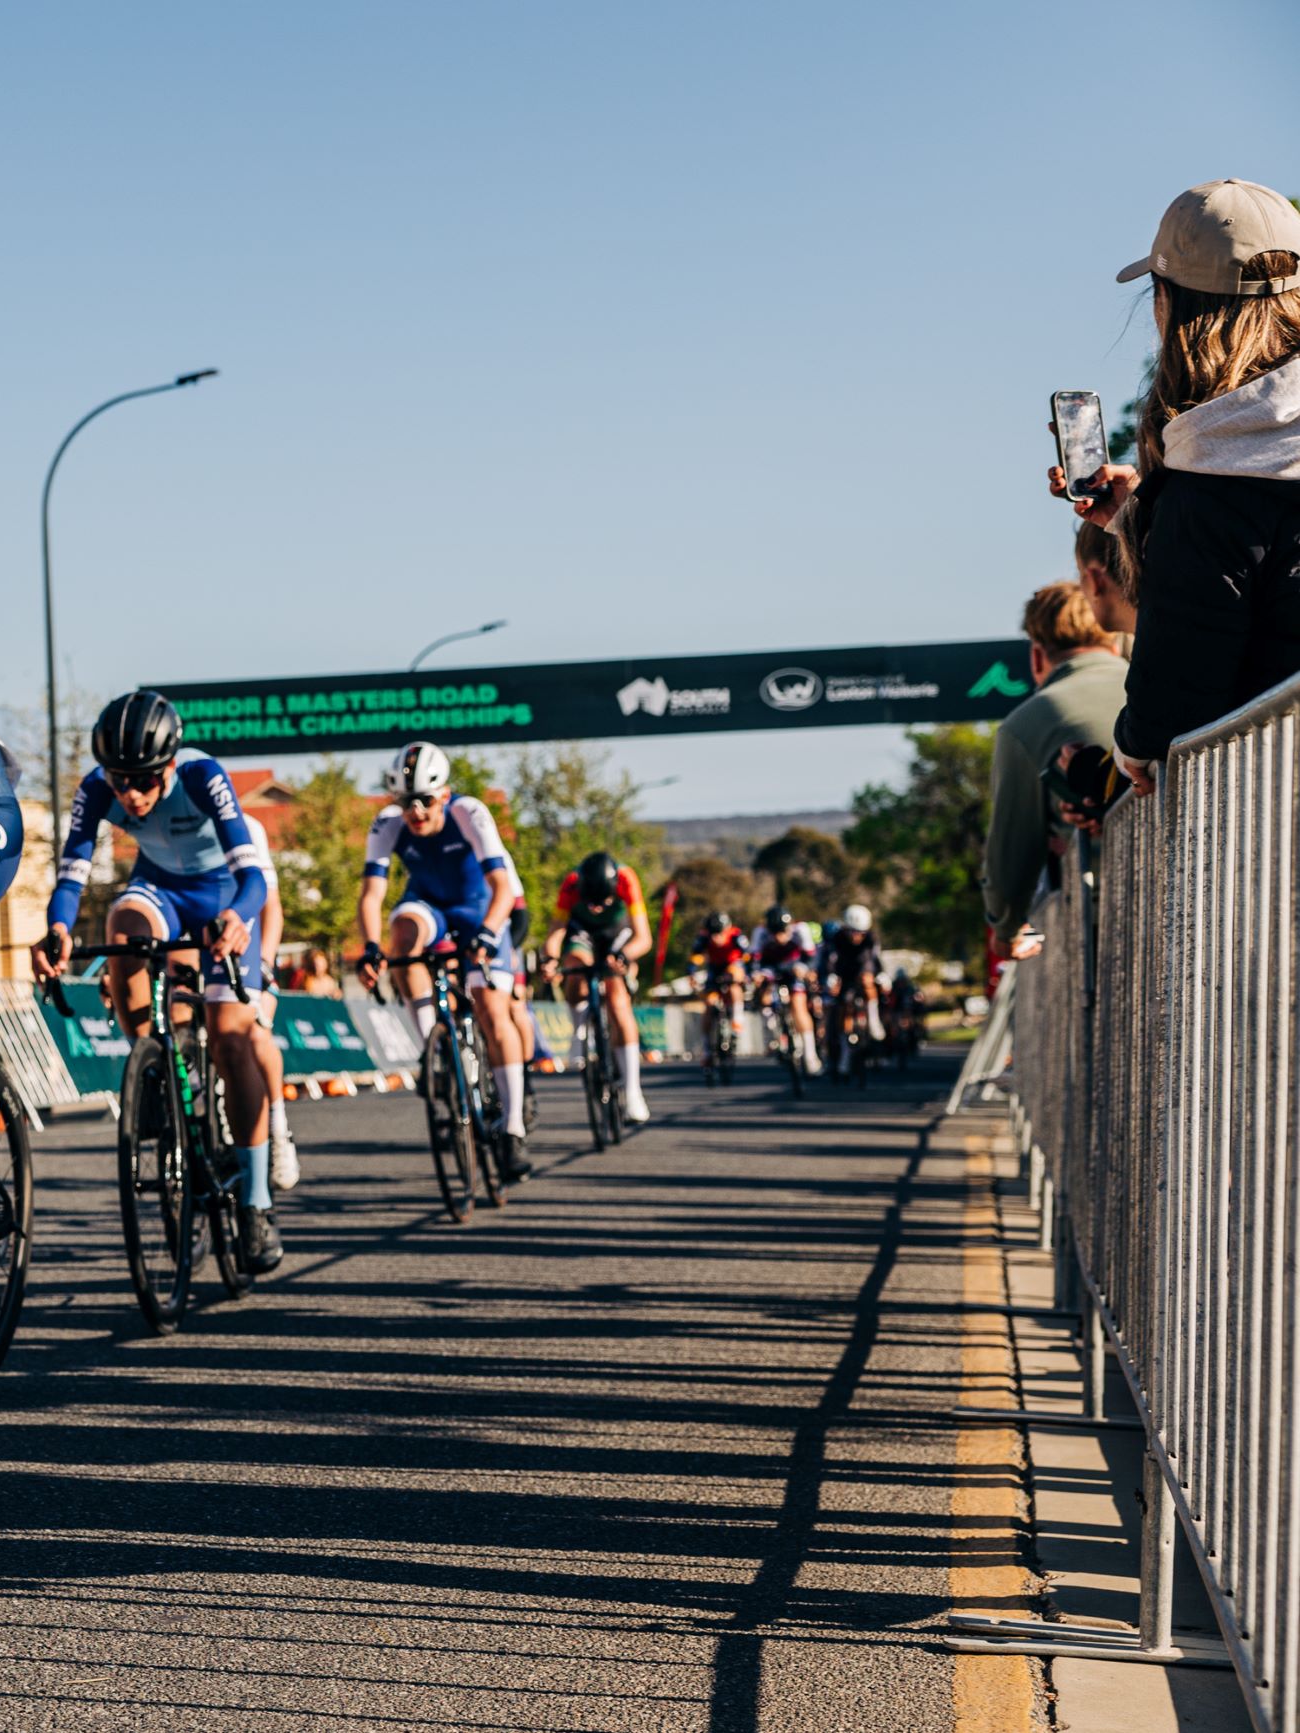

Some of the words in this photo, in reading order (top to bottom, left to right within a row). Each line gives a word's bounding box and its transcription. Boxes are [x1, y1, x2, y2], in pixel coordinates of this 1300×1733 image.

[176, 697, 262, 721] UNIOR
[265, 694, 283, 715] &
[286, 688, 417, 715] MASTERS
[420, 683, 498, 708] ROAD
[183, 716, 298, 742] ATIONAL
[300, 703, 532, 737] CHAMPIONSHIPS
[207, 774, 238, 820] NSW
